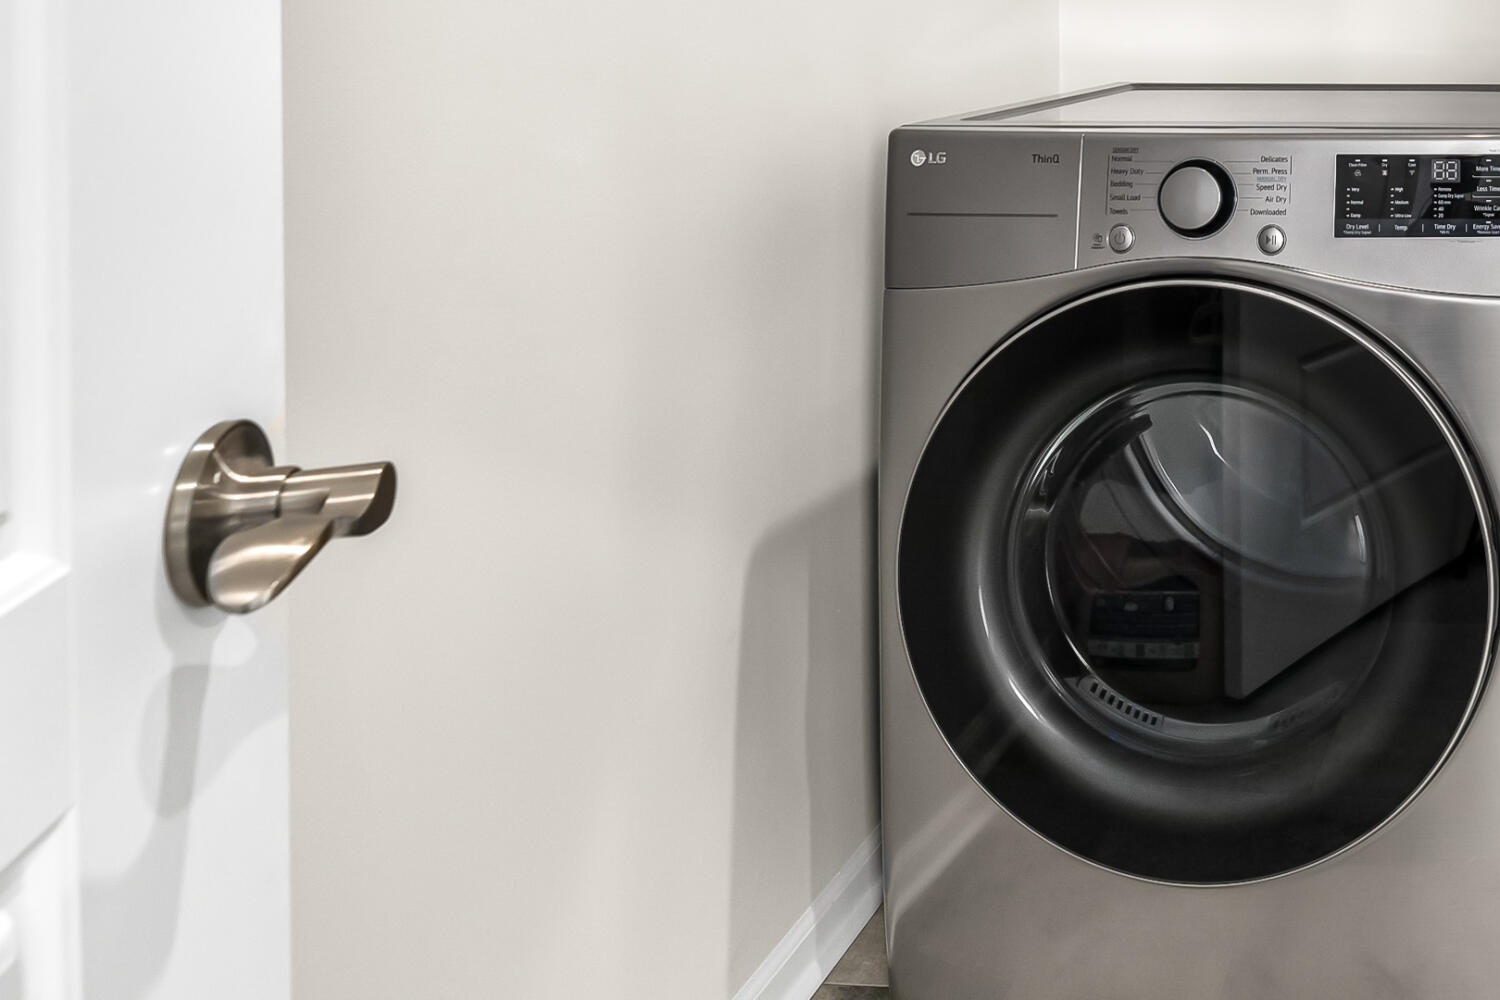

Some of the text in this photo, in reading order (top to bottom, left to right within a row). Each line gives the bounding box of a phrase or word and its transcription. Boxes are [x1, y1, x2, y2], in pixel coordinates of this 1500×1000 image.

[1032, 153, 1060, 164] ThinQ
[1260, 155, 1288, 163] Delicates
[1110, 168, 1144, 176] Heavy Duty
[1271, 167, 1288, 175] Press
[1256, 184, 1288, 192] Speed Dry
[1275, 196, 1287, 204] Dry
[1250, 208, 1287, 216] Downloaded
